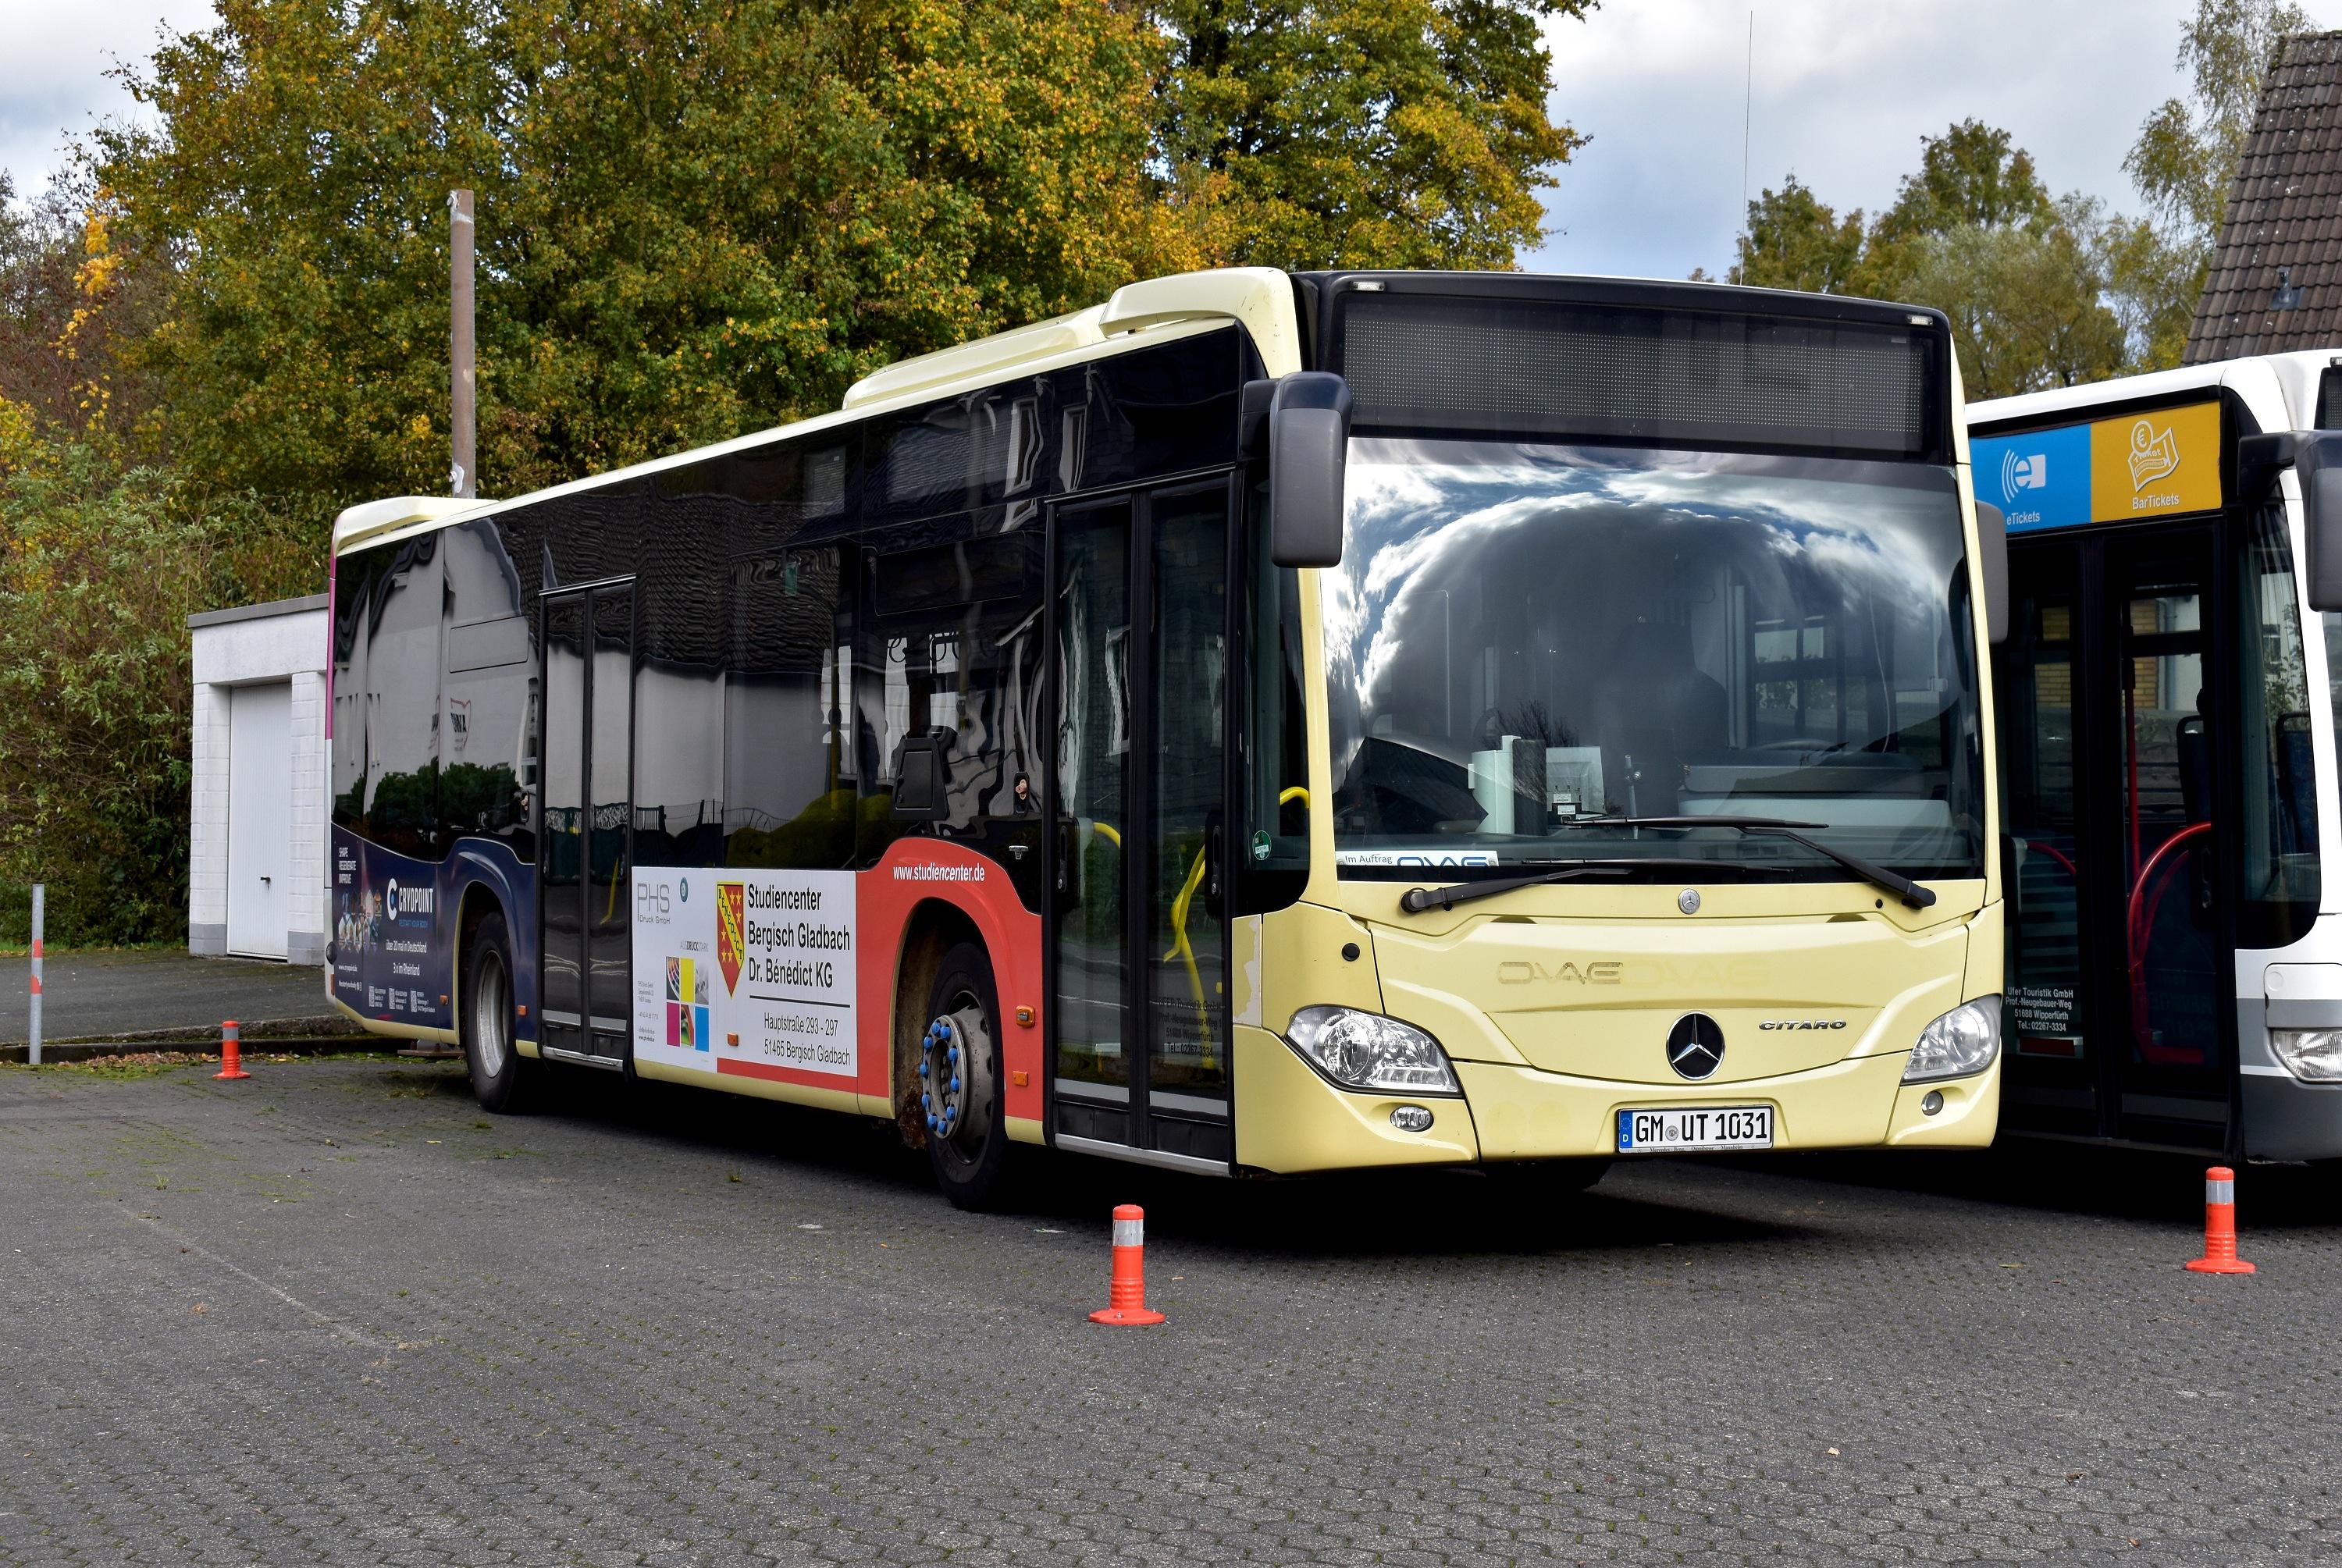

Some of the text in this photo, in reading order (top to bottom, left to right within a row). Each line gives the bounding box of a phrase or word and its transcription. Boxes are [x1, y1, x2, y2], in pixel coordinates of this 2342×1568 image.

[2132, 493, 2180, 510] BarTickets
[2006, 510, 2041, 525] eTickets
[1359, 854, 1393, 864] Auftrag
[893, 862, 985, 881] www.studiencenter.de
[399, 887, 433, 913] CRYOPOINT
[637, 883, 670, 921] PHS
[748, 884, 822, 910] Studiencenter
[749, 920, 850, 952] Bergisch Gladbach
[749, 957, 833, 987] Dr. Bénédict KG
[2007, 987, 2073, 998] Ufer Touristik GmbH
[2006, 997, 2073, 1010] Prof.-Neugebauer-Weg
[764, 1012, 804, 1034] Hauptstraße
[806, 1017, 818, 1034] 293
[825, 1019, 838, 1036] 297
[2034, 1009, 2069, 1020] Wipperfürth
[1759, 1019, 1847, 1031] CITARO
[2017, 1020, 2066, 1032] Tel.: 02267-3334
[764, 1039, 851, 1065] 51465 Bergisch Gladbach
[1635, 1115, 1664, 1142] GM
[1682, 1114, 1708, 1141] UT
[1715, 1112, 1767, 1140] 1031
